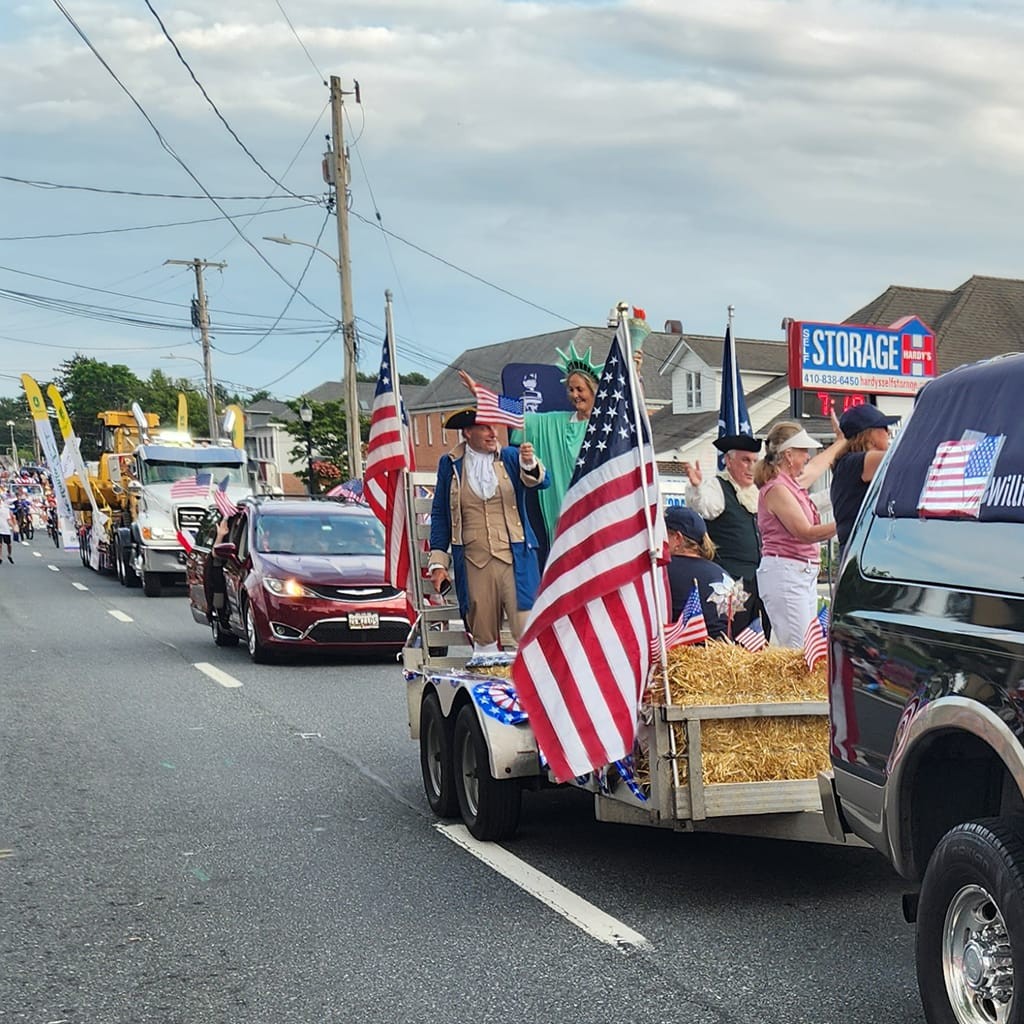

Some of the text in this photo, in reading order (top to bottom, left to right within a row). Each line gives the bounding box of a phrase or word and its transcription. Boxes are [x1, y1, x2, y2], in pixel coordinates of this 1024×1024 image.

[802, 328, 810, 364] SELF
[812, 328, 899, 371] STORAGE
[903, 350, 932, 361] HARDY'S
[804, 373, 860, 386] 410-838-6450
